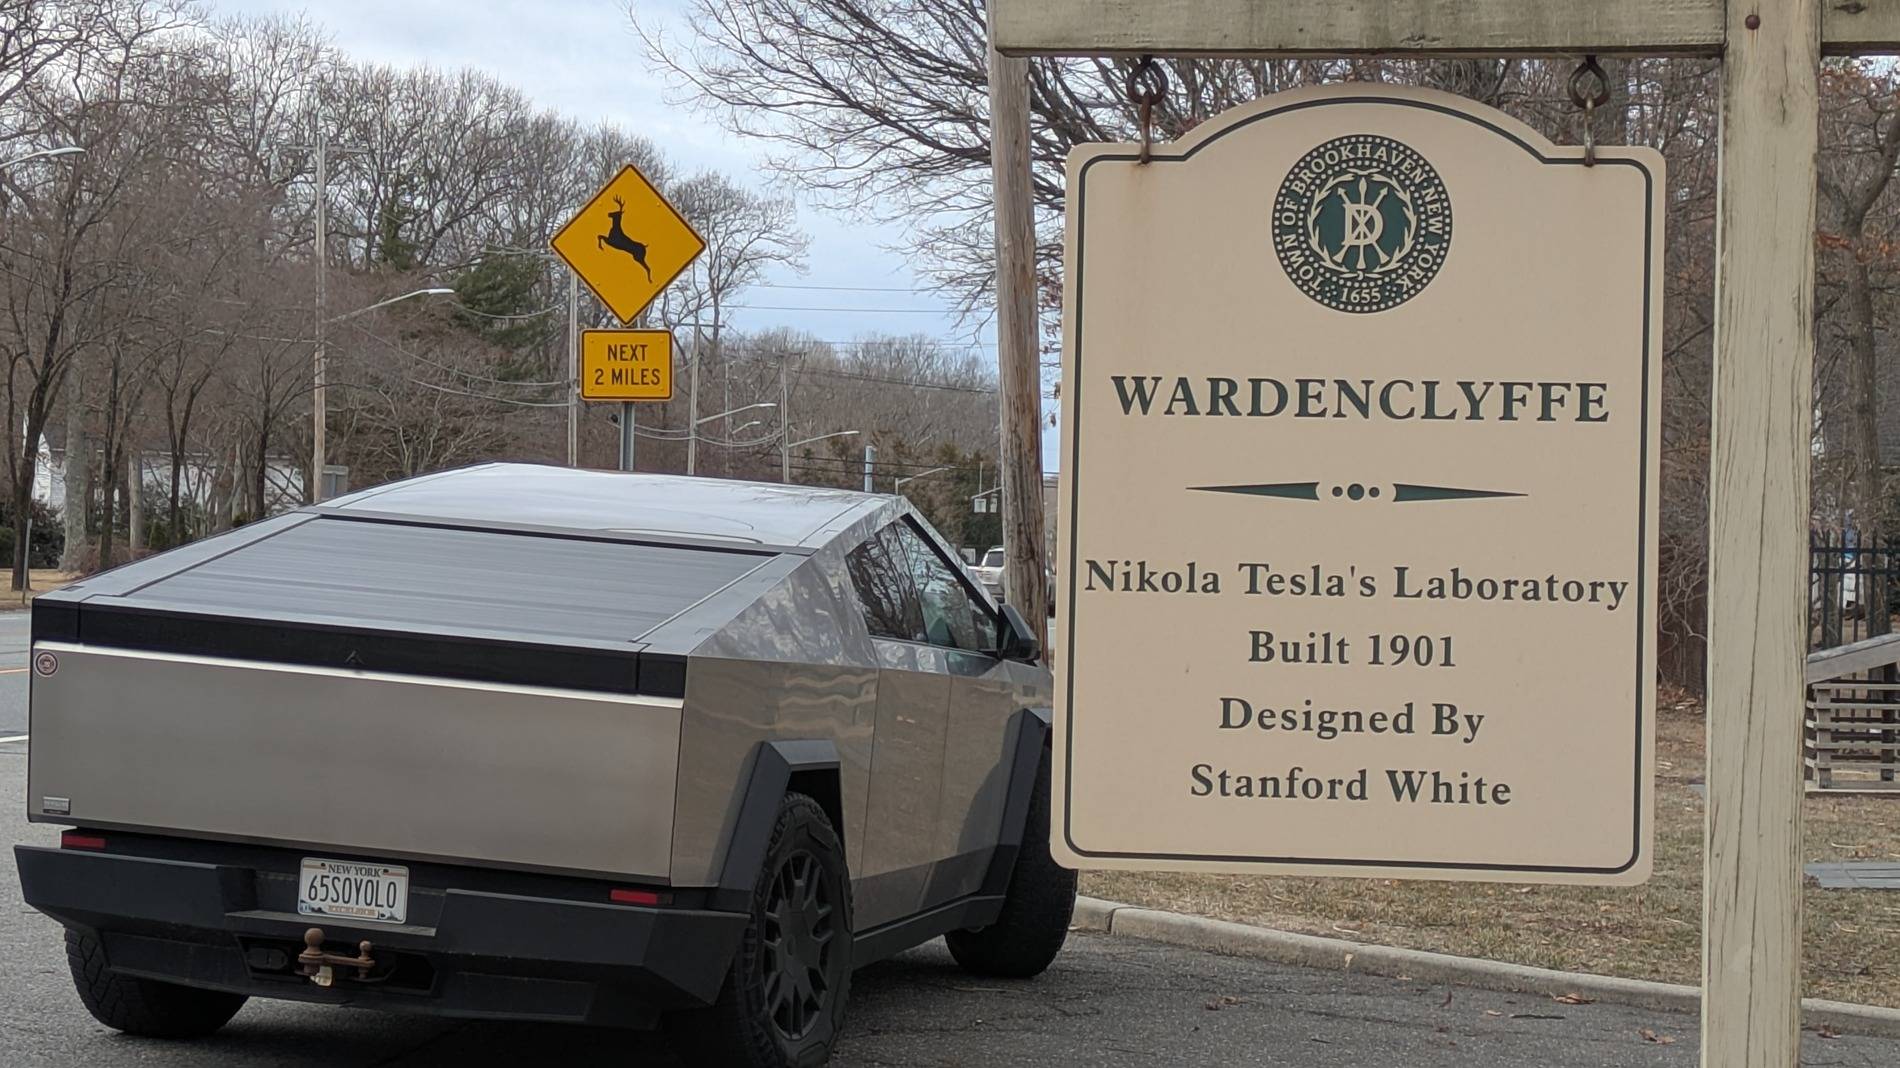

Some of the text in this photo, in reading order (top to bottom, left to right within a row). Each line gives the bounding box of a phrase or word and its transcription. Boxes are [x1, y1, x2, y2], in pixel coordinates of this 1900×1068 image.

[1281, 143, 1444, 293] TOWN OF BROOKHAVEN NEW YORK
[1340, 287, 1382, 304] 1655
[607, 343, 649, 362] NEXT
[594, 367, 661, 386] 2 MILES
[1110, 375, 1610, 424] WARDENCLYFFE
[1084, 559, 1630, 611] Nikola Tesla's Laboratory
[1248, 630, 1457, 668] Built 1901
[1218, 697, 1486, 744] Designed By
[1190, 763, 1512, 806] Stanford White
[328, 864, 381, 878] NEW YORK
